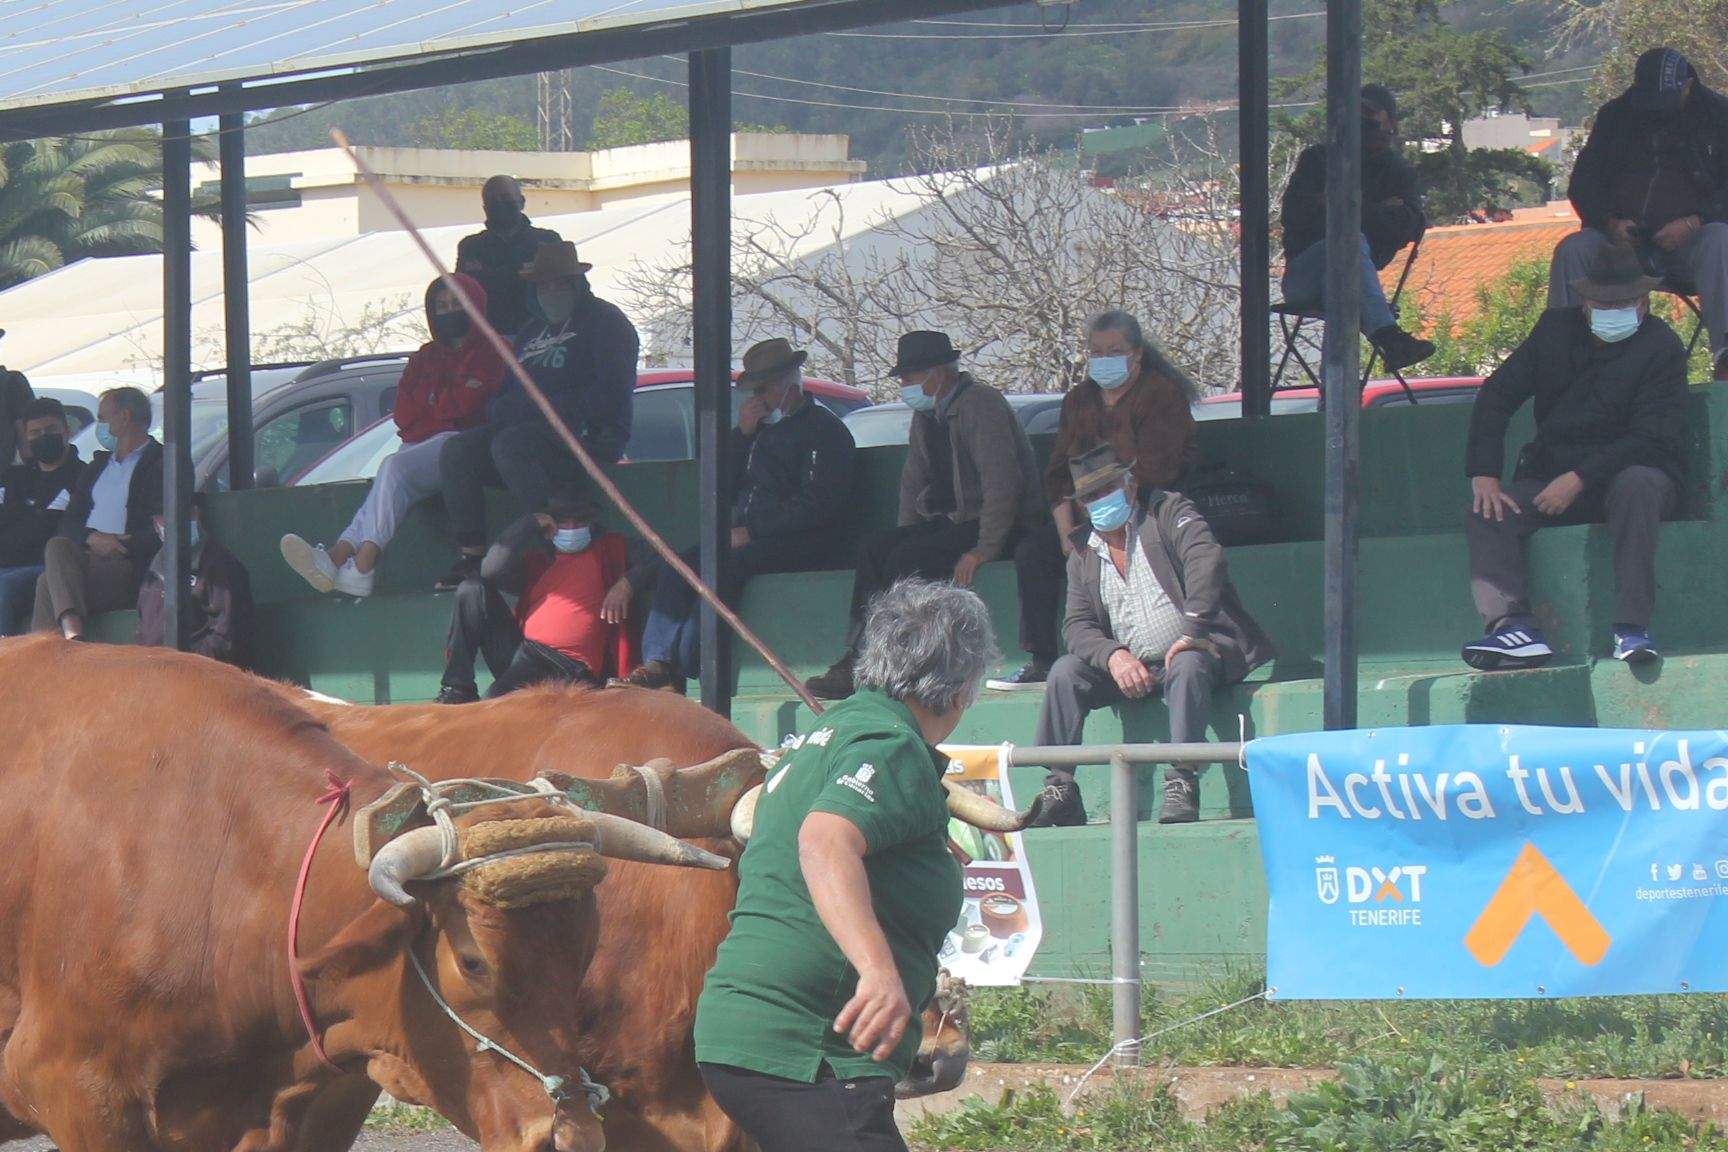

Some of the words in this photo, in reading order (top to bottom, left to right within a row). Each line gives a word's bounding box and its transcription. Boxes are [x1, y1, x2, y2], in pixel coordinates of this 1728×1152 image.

[1307, 752, 1496, 821] Activa
[1506, 755, 1585, 816] tu
[1593, 739, 1728, 811] vida
[1346, 866, 1427, 903] DXT
[1349, 909, 1422, 926] TENERIFE
